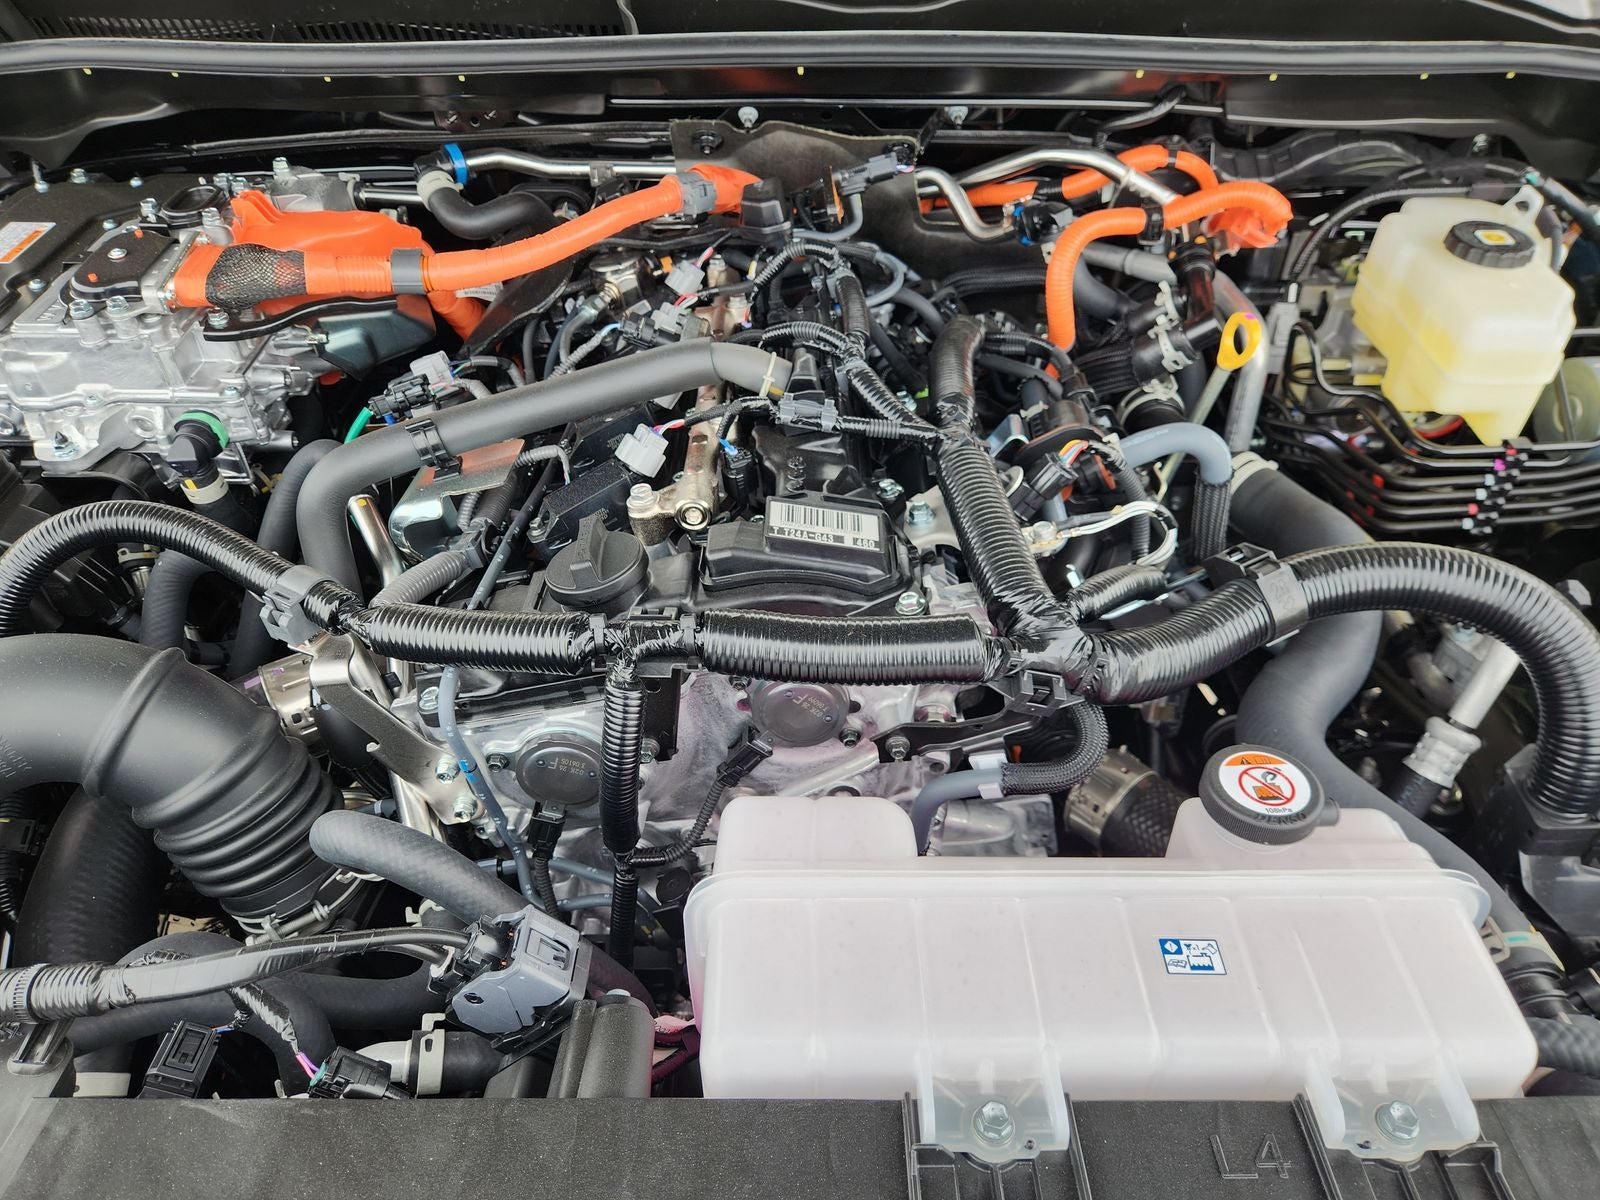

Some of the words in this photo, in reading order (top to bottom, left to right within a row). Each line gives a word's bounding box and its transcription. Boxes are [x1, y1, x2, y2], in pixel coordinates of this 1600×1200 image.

[772, 526, 780, 535] T
[784, 528, 834, 543] T24A-G43
[856, 539, 876, 549] 460
[792, 694, 808, 704] F
[547, 757, 559, 770] F
[1209, 1132, 1291, 1179] L4
